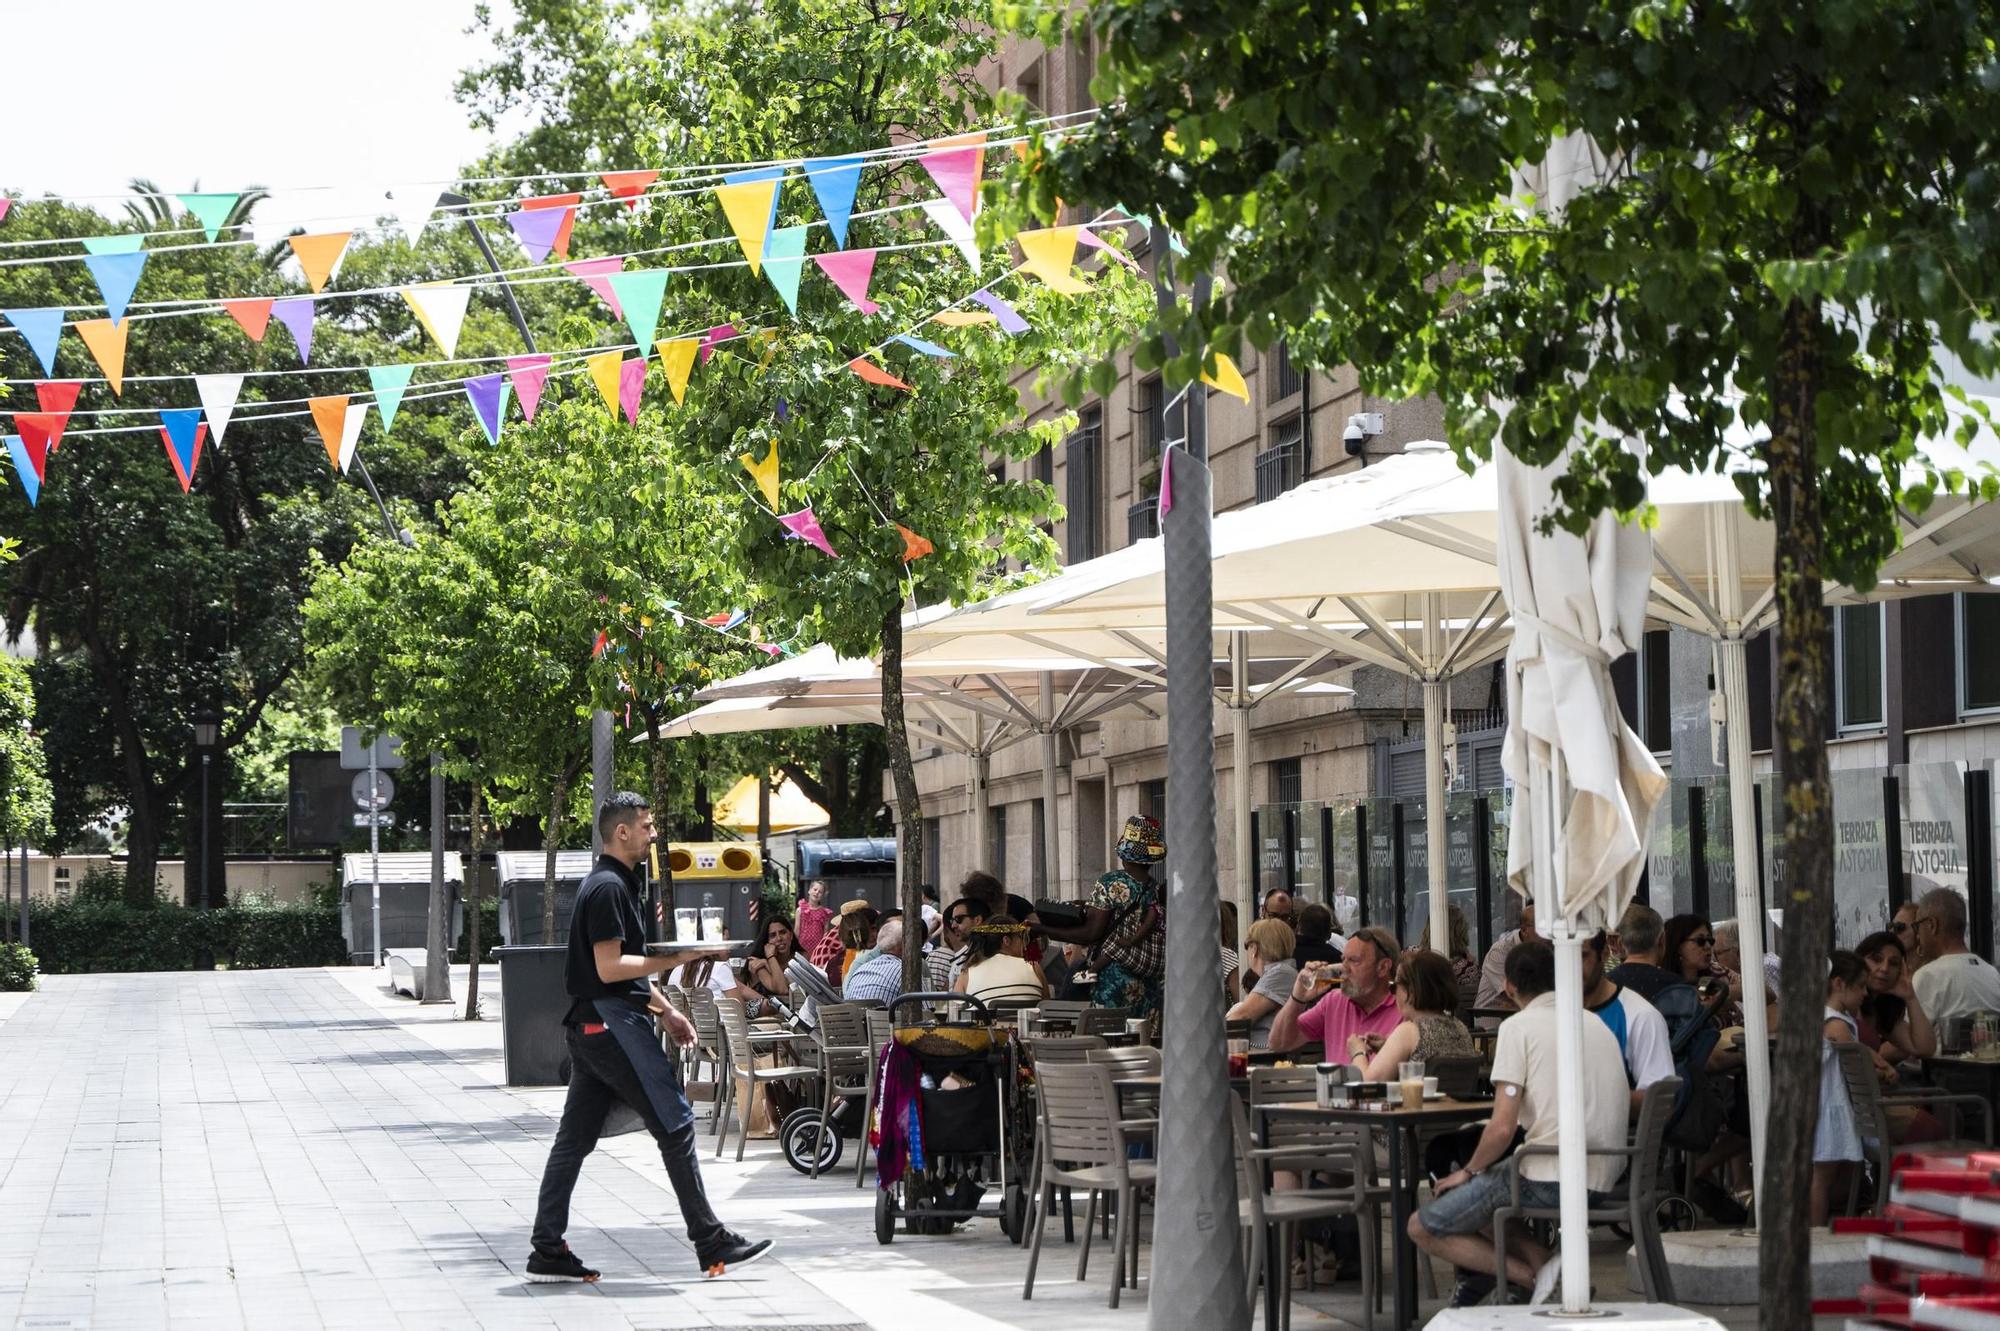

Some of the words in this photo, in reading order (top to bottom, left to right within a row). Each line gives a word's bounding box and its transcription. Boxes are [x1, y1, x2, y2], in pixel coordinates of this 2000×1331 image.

[1839, 821, 1878, 844] TERRAZA
[1909, 821, 1955, 844] TERRAZA
[1839, 848, 1884, 873] ASTORIA
[1909, 849, 1960, 874] ASTORIA
